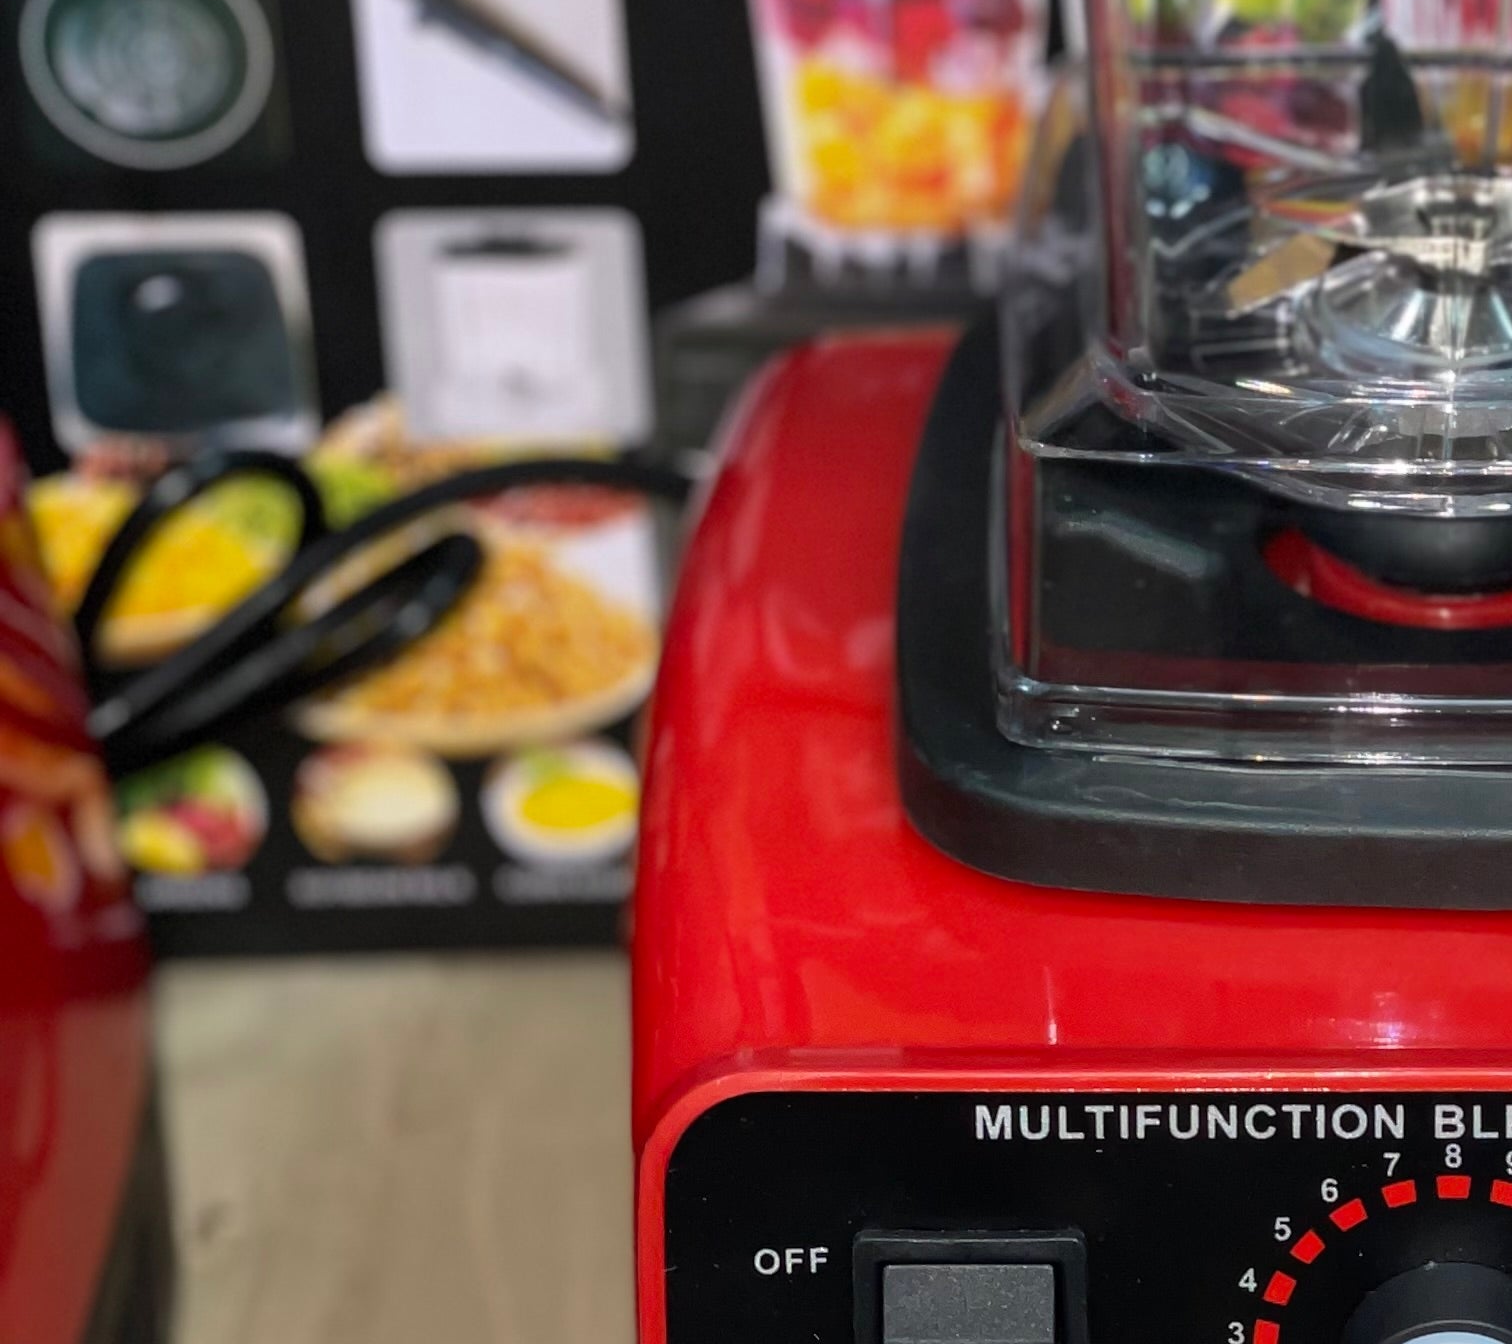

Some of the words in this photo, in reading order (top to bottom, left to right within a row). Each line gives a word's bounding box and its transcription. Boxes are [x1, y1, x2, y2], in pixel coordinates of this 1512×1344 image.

[974, 1102, 1406, 1141] MULTIFUNCTION
[1238, 1267, 1258, 1293] 4
[1274, 1216, 1292, 1242] 5
[1320, 1177, 1339, 1203] 6
[1383, 1152, 1401, 1177] 7
[1444, 1143, 1463, 1169] 8
[752, 1245, 830, 1276] OFF
